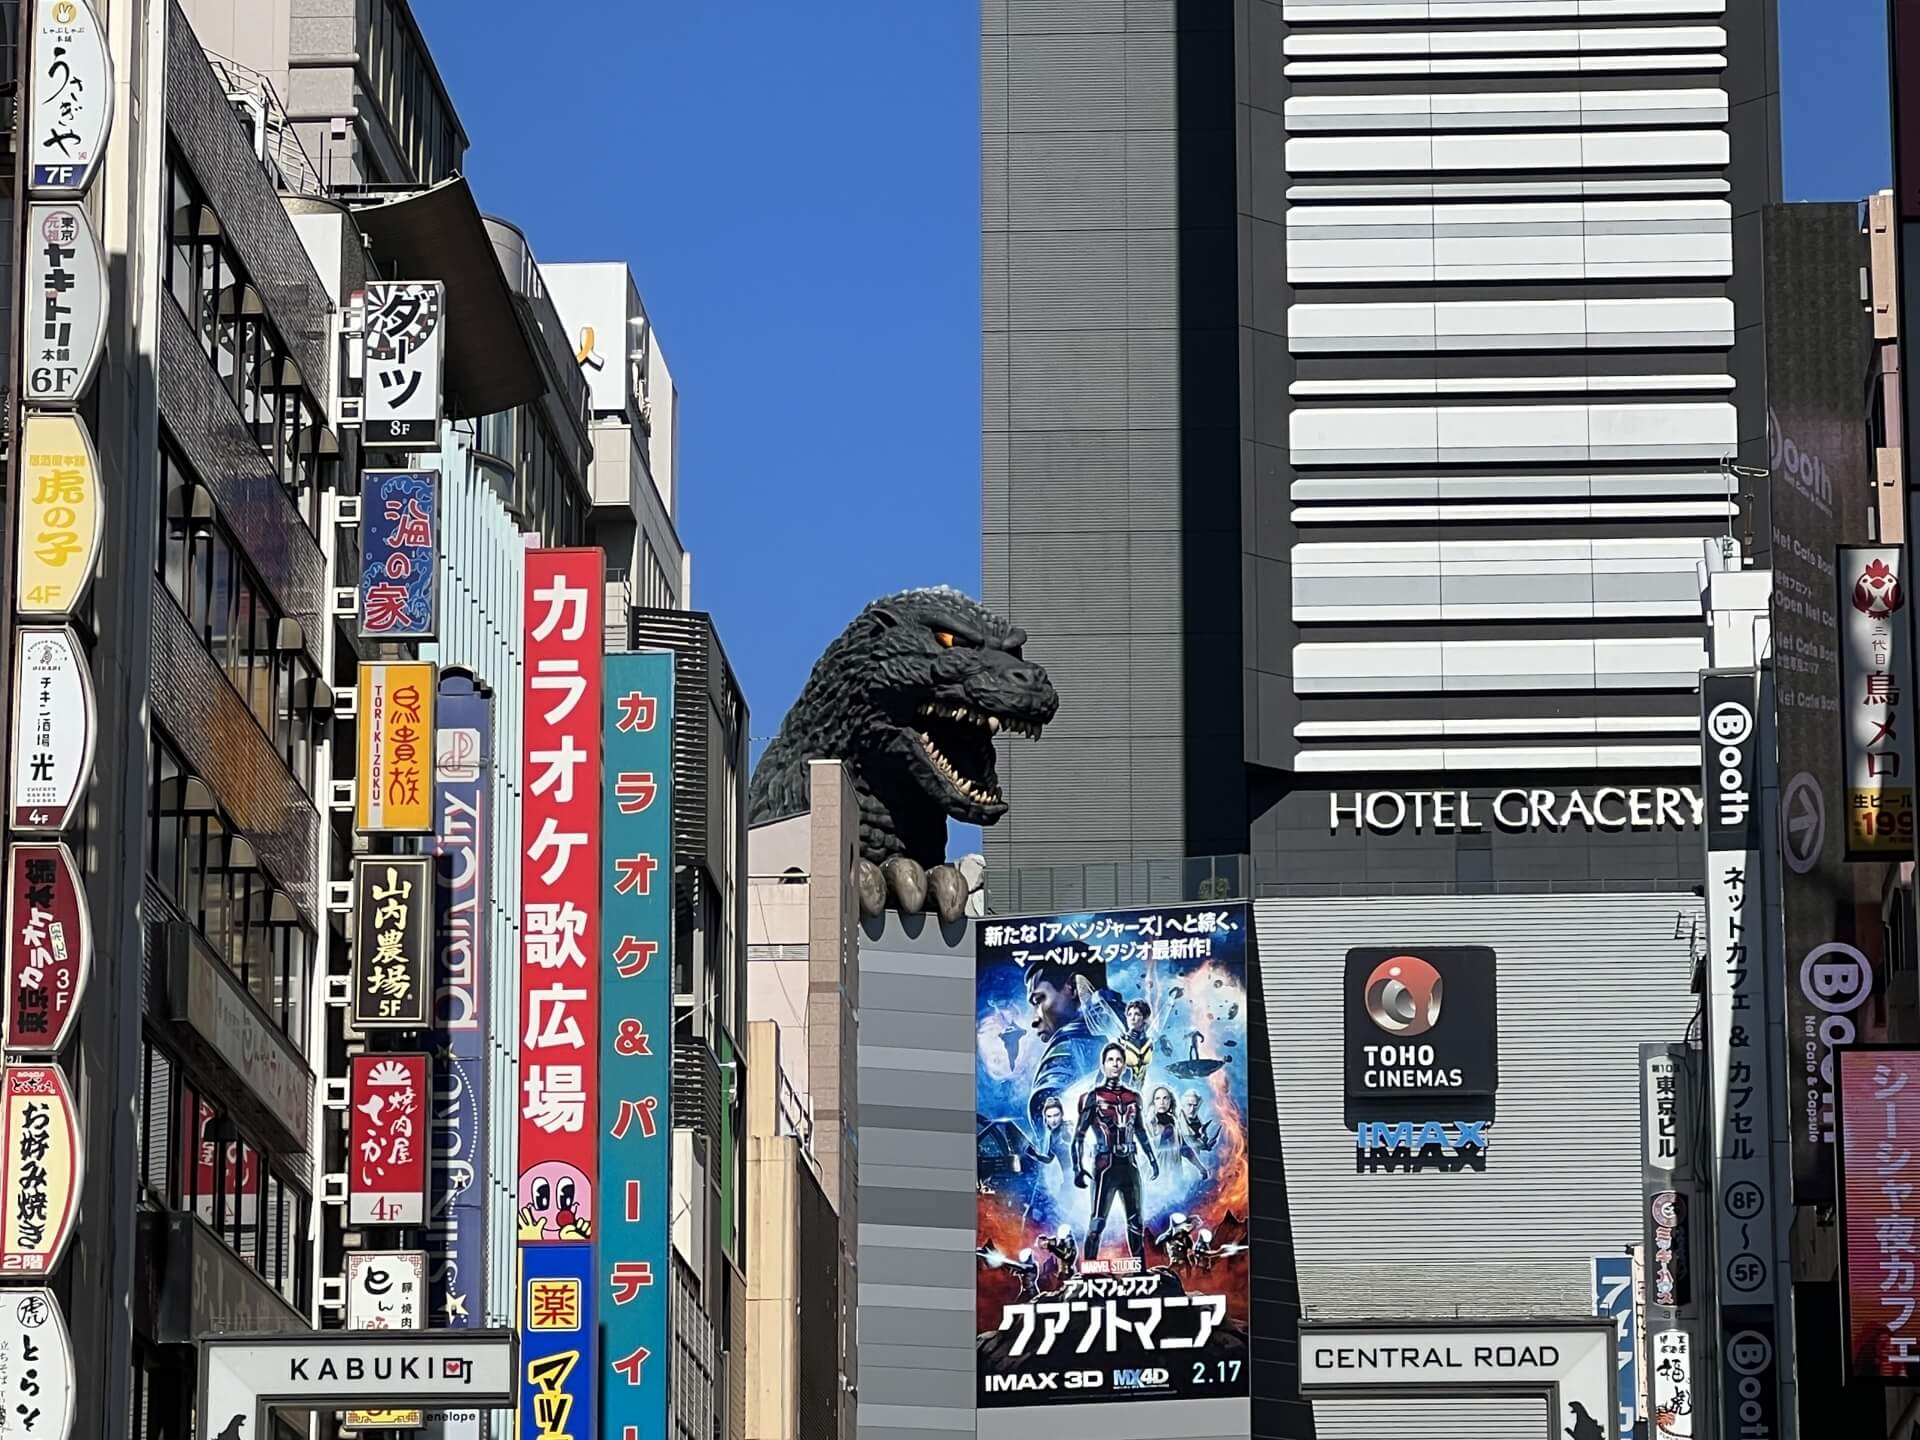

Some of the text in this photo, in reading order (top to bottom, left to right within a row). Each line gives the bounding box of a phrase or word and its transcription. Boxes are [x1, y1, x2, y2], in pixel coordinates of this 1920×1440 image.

[42, 47, 83, 158] うさぎや
[45, 167, 73, 185] 7F
[44, 243, 76, 347] ヤキトリ
[42, 348, 70, 362] 本舗
[379, 290, 428, 409] ダーツ
[31, 367, 79, 393] 6F
[390, 420, 410, 436] 8F
[32, 469, 85, 567] 虎の子
[365, 500, 432, 632] 海の家
[27, 585, 61, 604] 4F
[1871, 626, 1888, 665] 三代目
[36, 676, 52, 747] チキン酒場
[1862, 671, 1900, 778] 鳥メロ
[374, 686, 383, 802] TORIKIZOKU
[389, 685, 420, 805] 鳥貴族
[1709, 702, 1752, 826] Booth
[30, 753, 55, 782] 光
[29, 809, 49, 824] 4F
[1329, 787, 1704, 829] HOTEL GRACERY
[523, 575, 589, 1134] カラオケ歌広場
[367, 867, 411, 998] 山内農場
[56, 968, 70, 1012] 3F
[379, 1000, 401, 1017] 5F
[1724, 866, 1755, 1160] ネットカフェ & カプセル
[1363, 1044, 1435, 1066] TOHO
[1363, 1068, 1464, 1088] CINEMAS
[387, 1087, 417, 1164] 焼肉屋
[1357, 1120, 1488, 1148] IMAX
[1656, 1075, 1679, 1158] 東京ビル
[357, 1095, 388, 1187] さかい
[17, 1102, 50, 1249] お好み焼き
[370, 1197, 402, 1221] 4F
[1733, 1191, 1757, 1210] 8F
[3, 1255, 43, 1270] 2階
[1081, 1258, 1142, 1273] MARVEL STUDIOS
[1735, 1263, 1759, 1282] 5F
[20, 1297, 46, 1327] 虎
[534, 1285, 575, 1325] 薬
[998, 1294, 1228, 1357] クアントマニア
[985, 1360, 1242, 1392] IMAX 3D MX4D 2.17
[1315, 1346, 1560, 1369] CENTRAL ROAD
[1727, 1330, 1772, 1440] Boot
